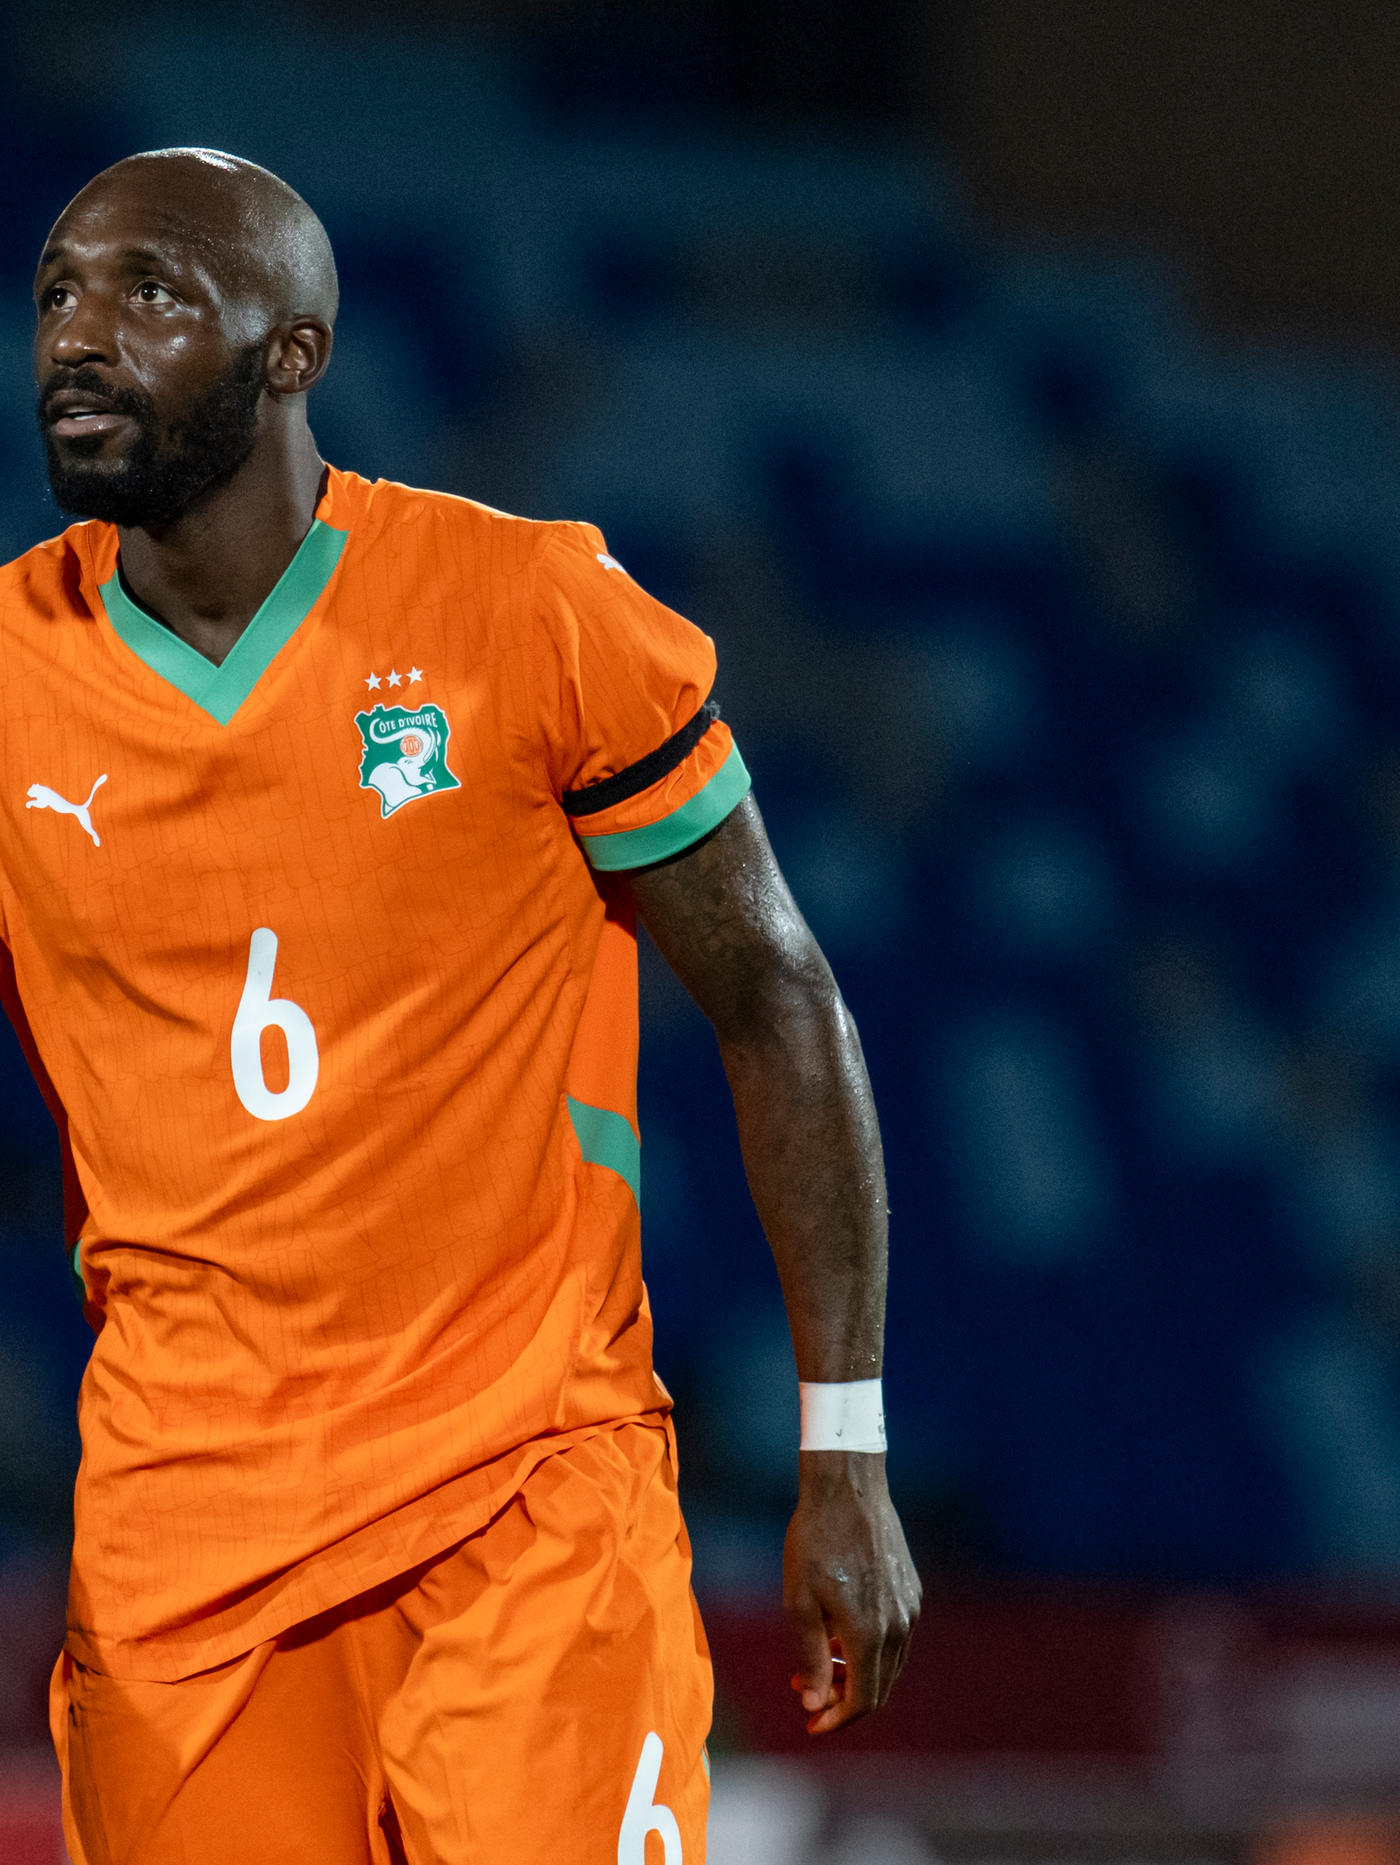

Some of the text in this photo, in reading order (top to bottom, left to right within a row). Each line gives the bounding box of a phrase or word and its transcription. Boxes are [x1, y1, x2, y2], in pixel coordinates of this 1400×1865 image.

[398, 712, 438, 728] D'IVOIRE
[231, 928, 319, 1121] 6
[618, 1731, 683, 1865] 6
